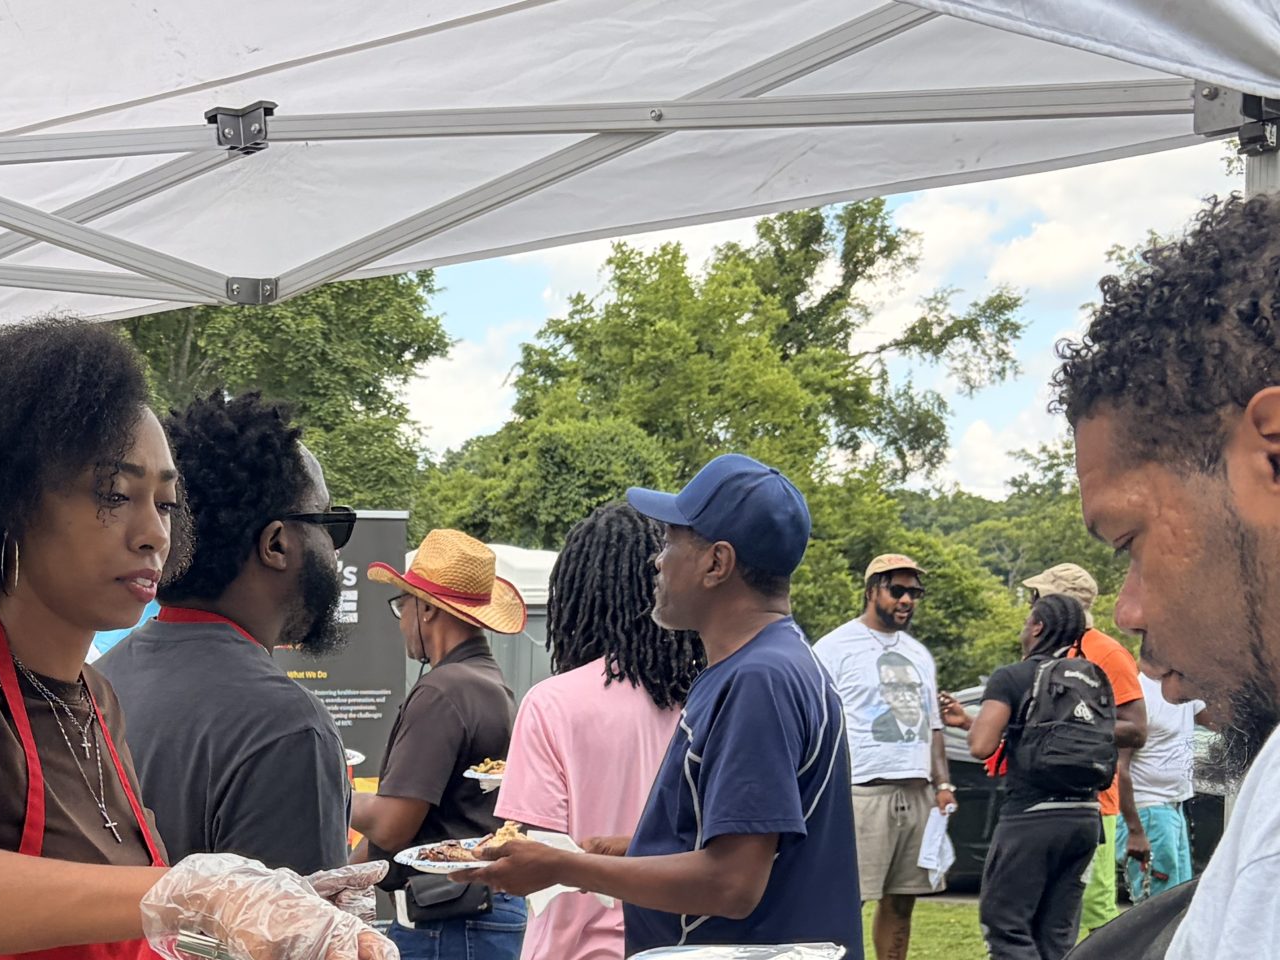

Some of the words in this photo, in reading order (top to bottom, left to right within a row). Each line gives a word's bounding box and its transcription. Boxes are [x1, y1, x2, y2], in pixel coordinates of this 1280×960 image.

[287, 671, 305, 679] What
[306, 671, 316, 679] We
[318, 671, 327, 679] Do
